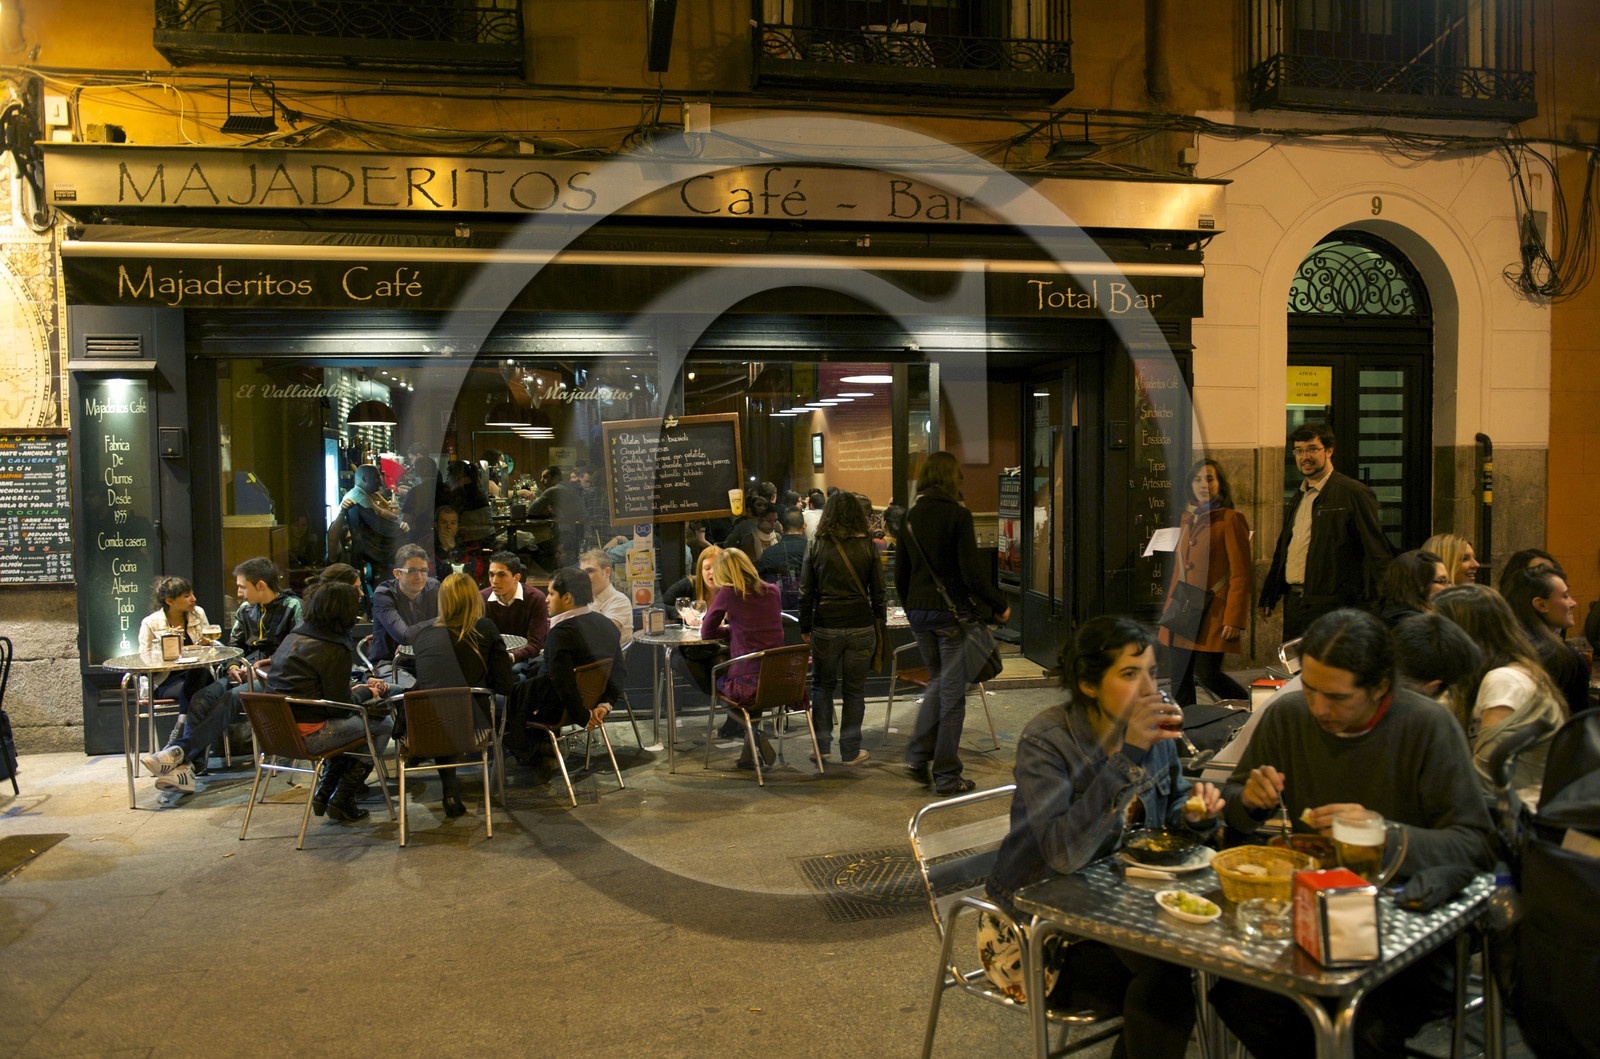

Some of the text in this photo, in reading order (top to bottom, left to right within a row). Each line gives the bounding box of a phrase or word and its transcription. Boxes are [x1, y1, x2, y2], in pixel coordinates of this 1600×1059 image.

[118, 161, 597, 212] MAJADERITOS
[680, 167, 807, 218] Café
[887, 179, 975, 221] Bar
[1371, 196, 1383, 215] 9
[117, 265, 424, 306] Majaderitos Café
[1028, 280, 1163, 314] Total Bar
[539, 380, 633, 404] Majadeitos
[112, 453, 124, 468] De
[104, 467, 133, 487] Churros
[107, 488, 132, 507] Desde
[97, 531, 147, 551] Comida casera
[111, 557, 137, 576] Cocina
[111, 577, 138, 595] Abierta
[114, 597, 135, 616] Todo
